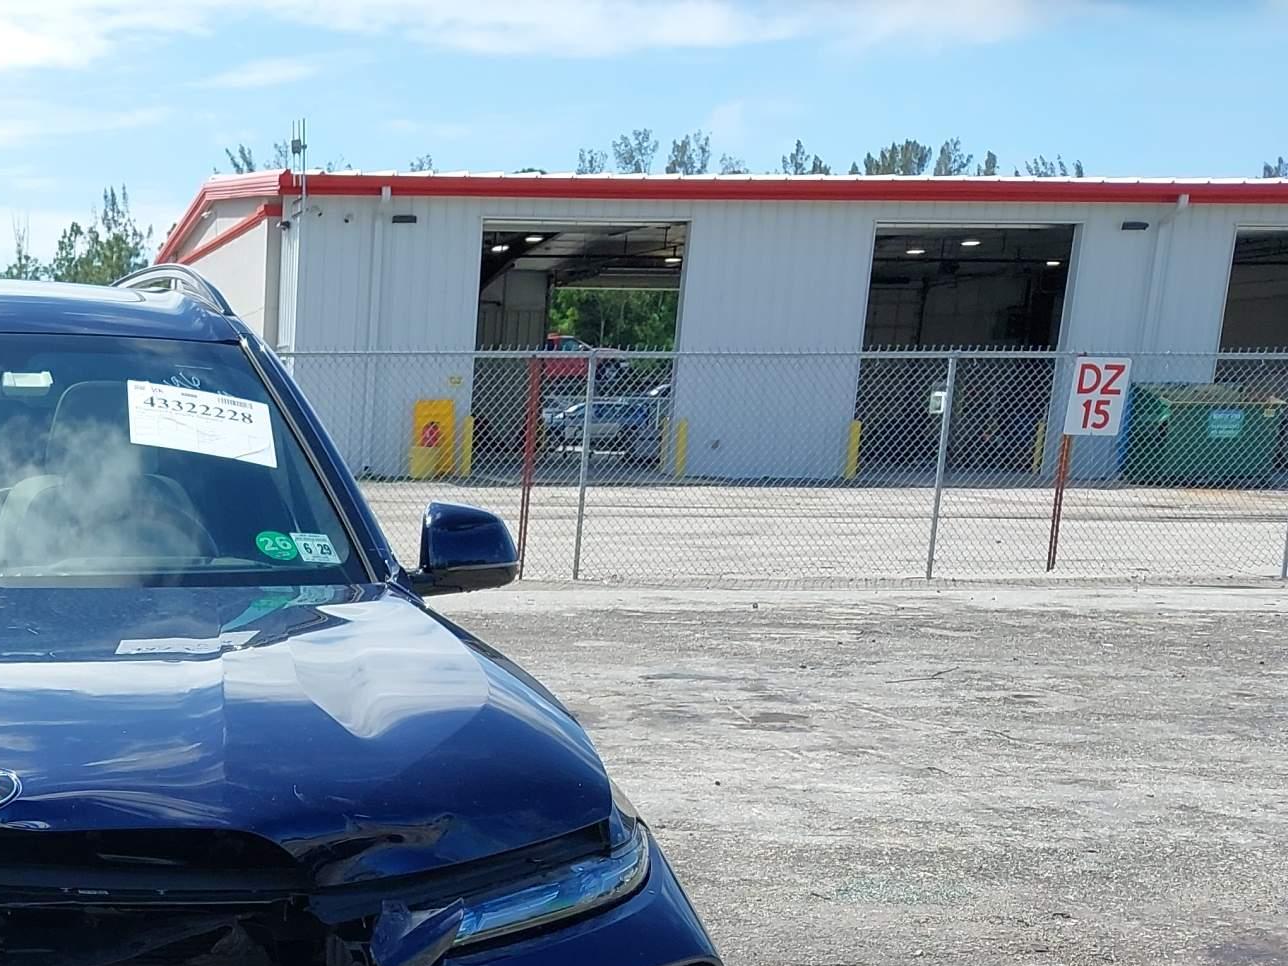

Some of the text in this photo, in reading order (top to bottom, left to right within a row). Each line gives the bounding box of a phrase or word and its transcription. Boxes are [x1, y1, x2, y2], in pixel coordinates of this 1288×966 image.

[1076, 363, 1126, 395] DZ
[143, 396, 253, 425] 43322228
[1081, 399, 1111, 429] 15
[259, 536, 292, 551] 26
[303, 542, 313, 555] 6
[317, 543, 332, 556] 29
